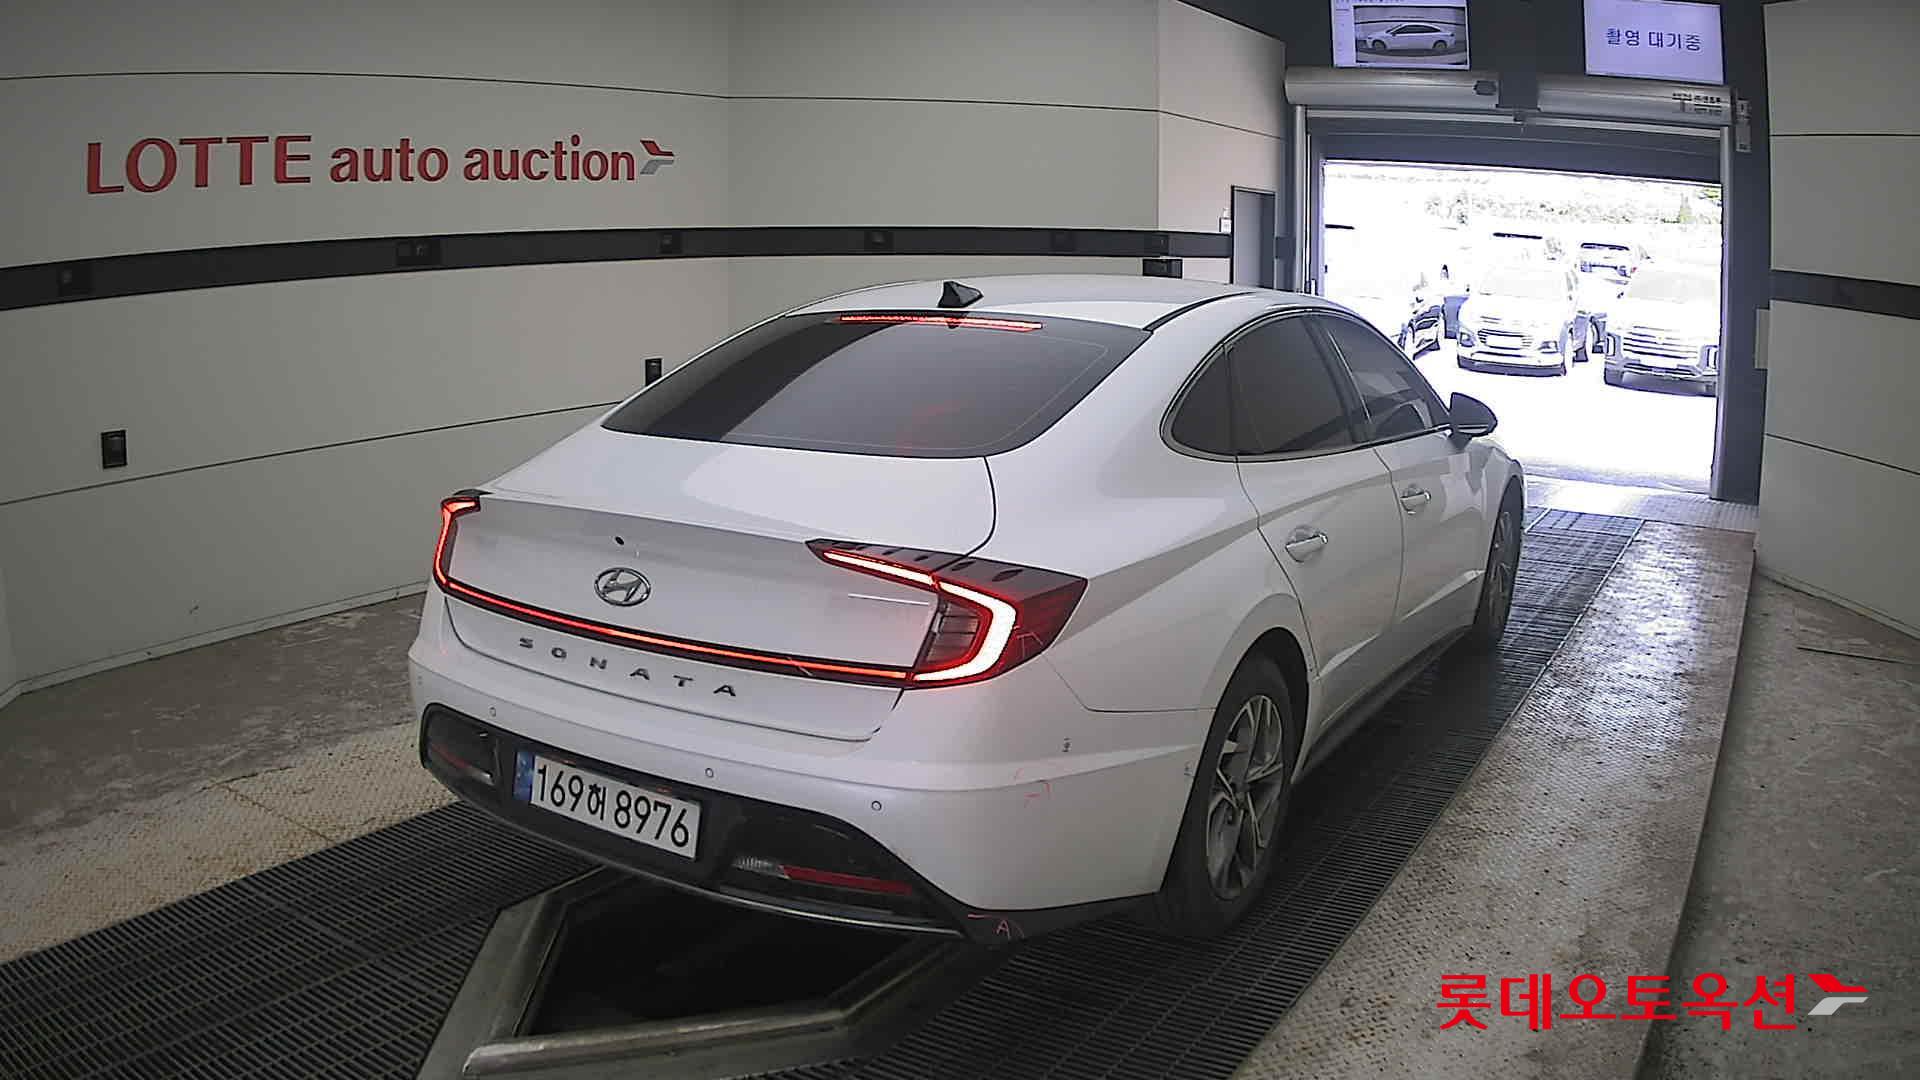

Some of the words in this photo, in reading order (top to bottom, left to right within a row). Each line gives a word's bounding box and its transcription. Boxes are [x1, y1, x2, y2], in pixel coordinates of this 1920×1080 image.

[1606, 27, 1640, 47] 촬영
[1648, 31, 1701, 52] 대기중
[87, 135, 312, 194] LOTTE
[329, 138, 449, 182] auto
[464, 134, 635, 182] auction
[519, 637, 737, 697] SONATA
[537, 764, 607, 821] 169허
[614, 790, 689, 848] 8976
